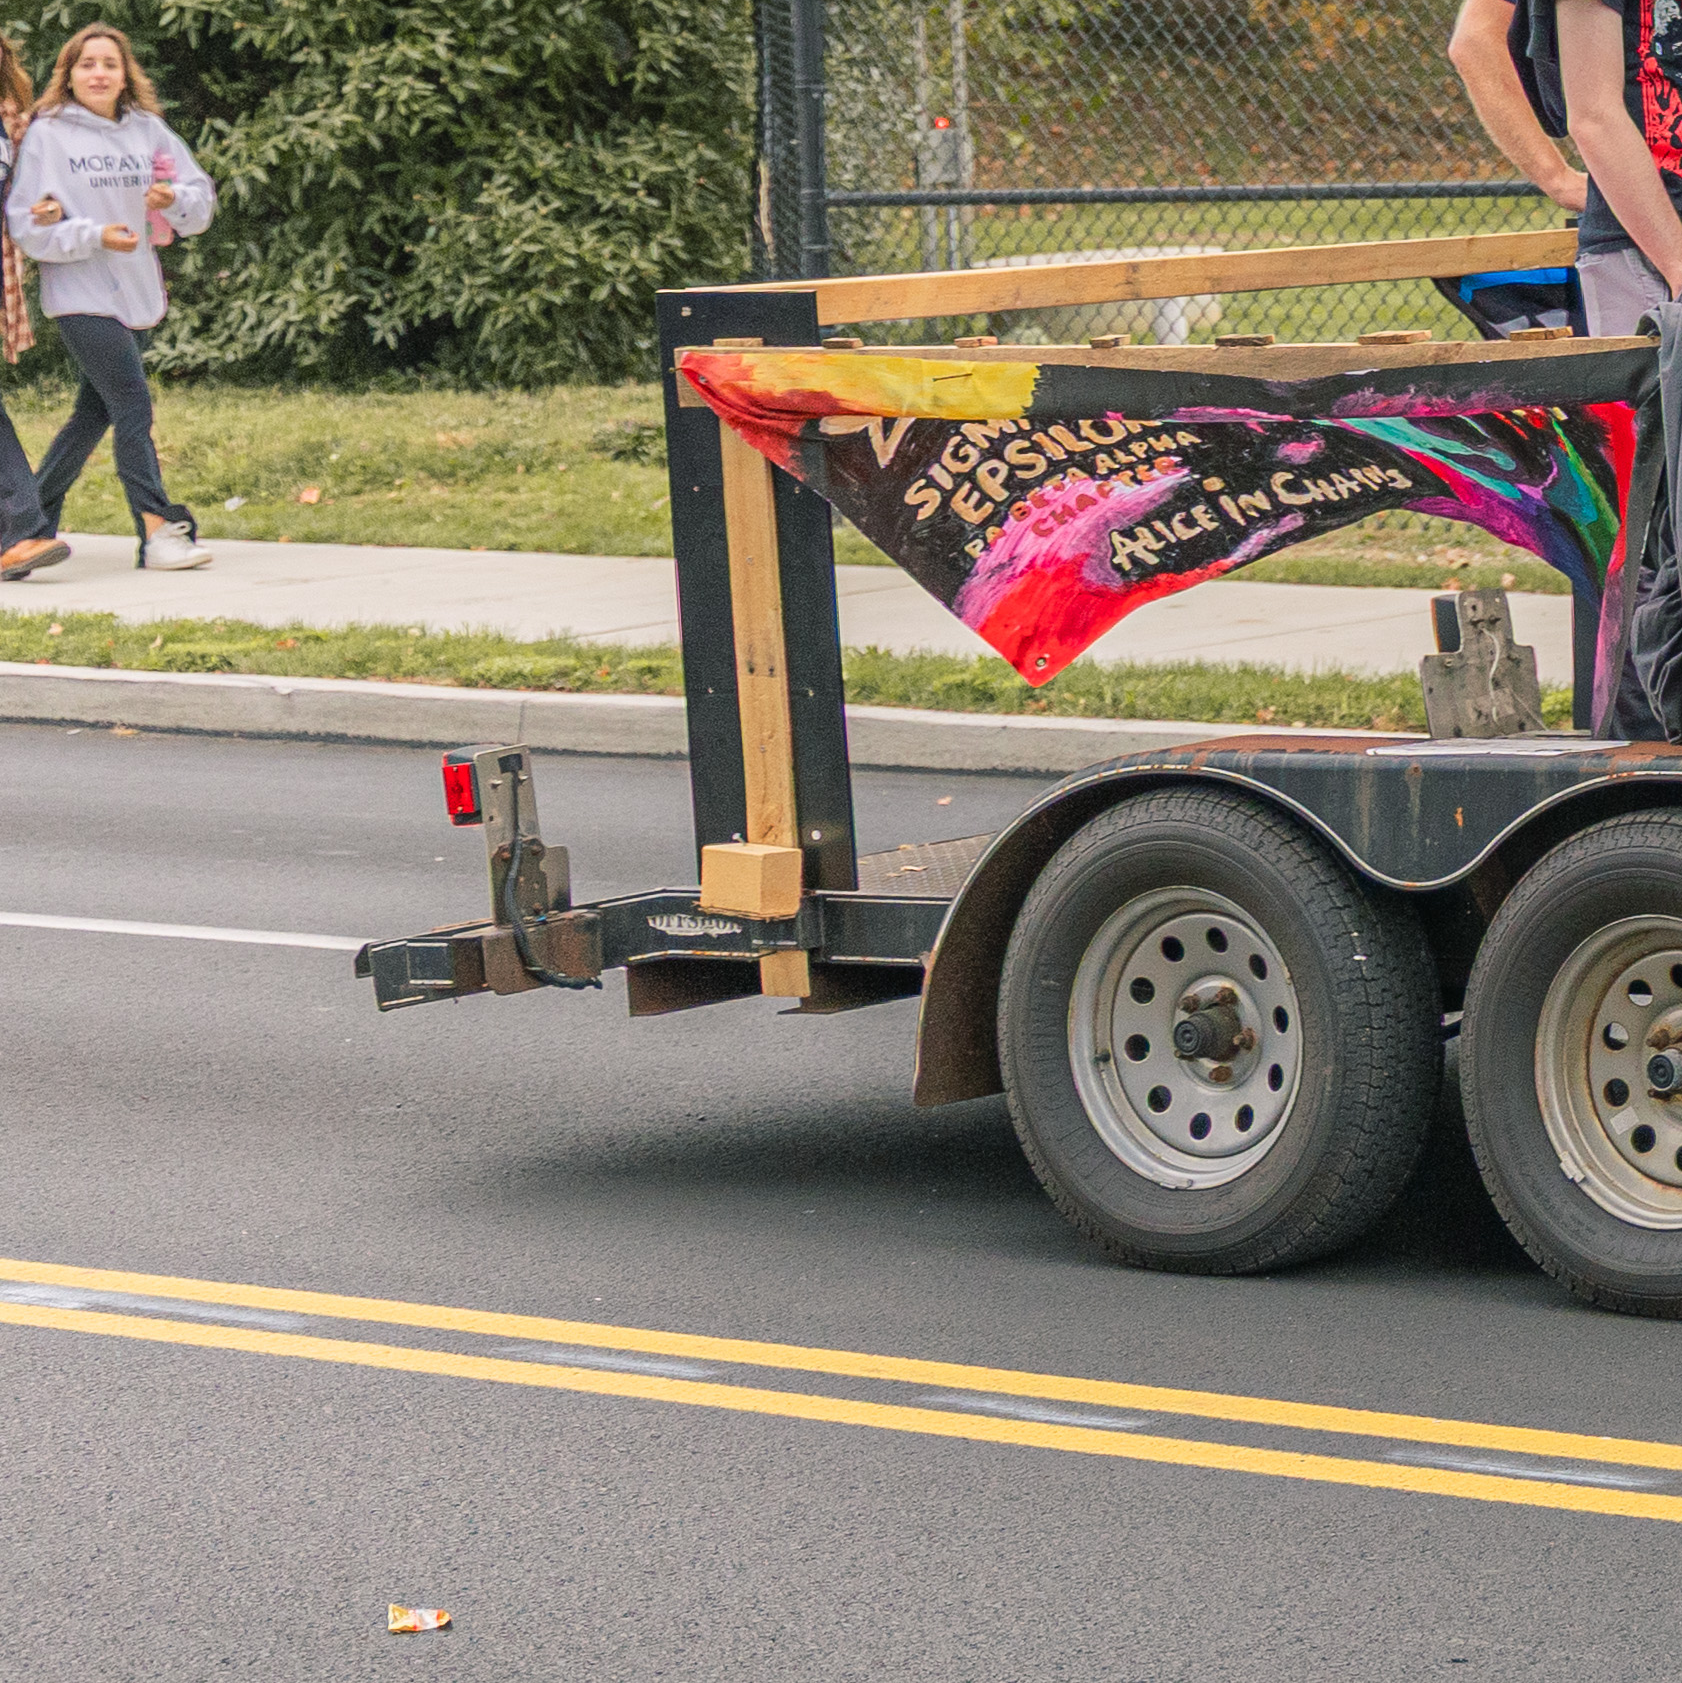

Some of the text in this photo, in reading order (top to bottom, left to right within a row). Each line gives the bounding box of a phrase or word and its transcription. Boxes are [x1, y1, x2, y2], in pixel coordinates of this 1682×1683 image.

[1094, 429, 1202, 475] ALPHA
[1109, 464, 1414, 571] ALICE IN CHAINS
